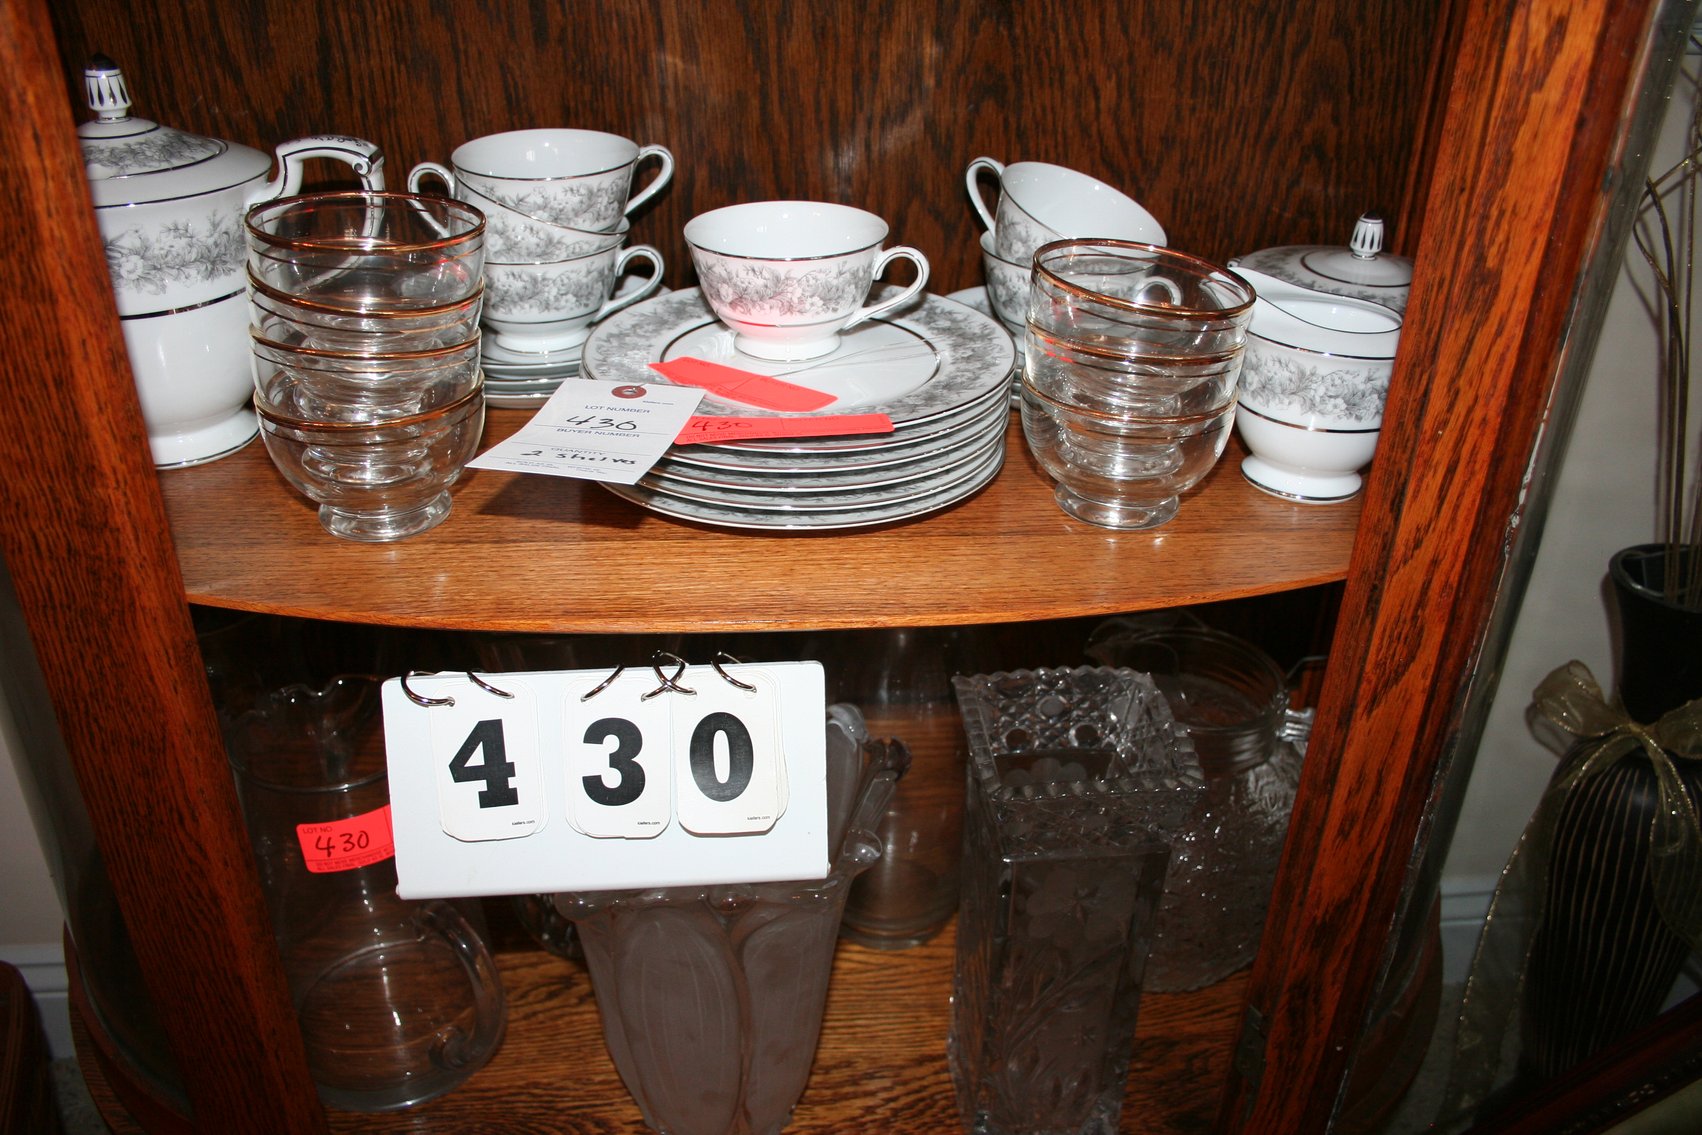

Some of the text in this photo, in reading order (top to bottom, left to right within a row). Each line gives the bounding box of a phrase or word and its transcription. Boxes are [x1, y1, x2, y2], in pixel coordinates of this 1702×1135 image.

[606, 406, 651, 414] NUMBER
[566, 415, 637, 431] 430
[595, 431, 641, 439] NUMBER
[550, 447, 606, 456] QUANTITY
[302, 826, 318, 834] LOT
[315, 830, 369, 858] 430
